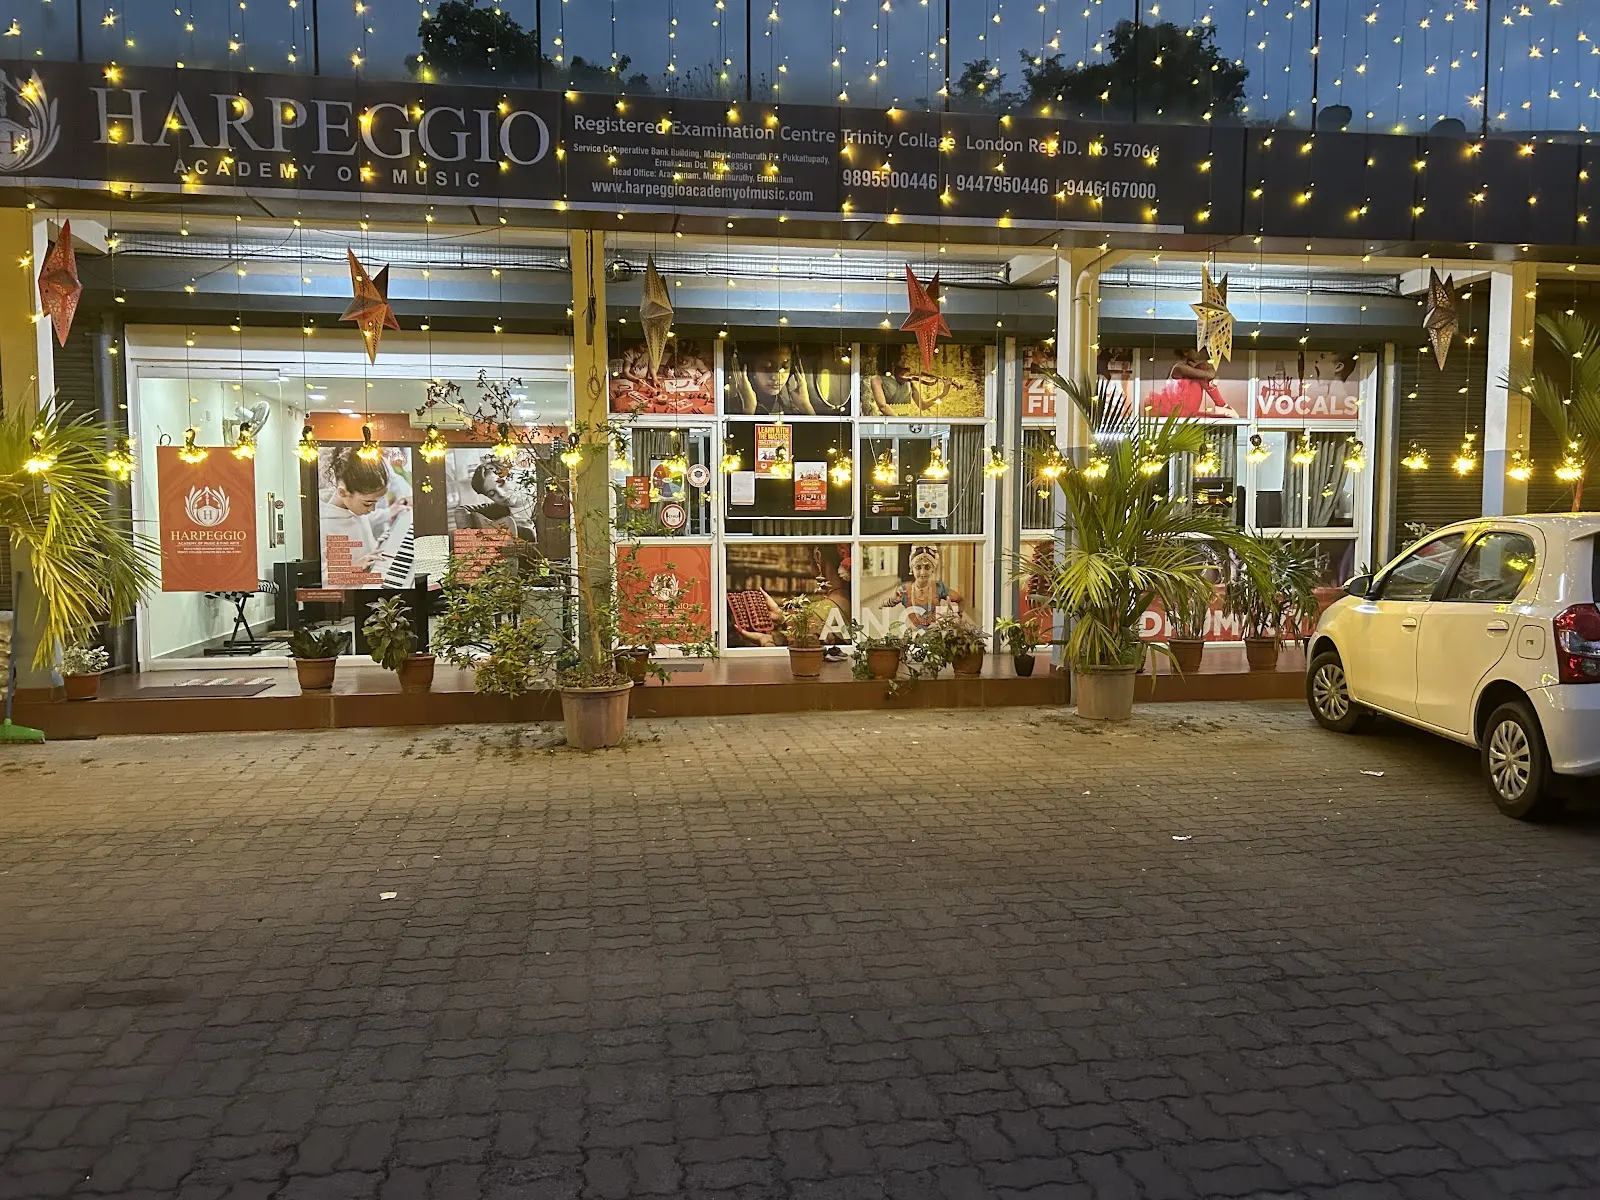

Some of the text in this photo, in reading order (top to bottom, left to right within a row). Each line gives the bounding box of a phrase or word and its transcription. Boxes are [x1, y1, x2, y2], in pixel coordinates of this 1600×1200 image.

[89, 87, 549, 165] HARPEGGIO
[574, 115, 666, 135] Registered
[671, 120, 774, 140] Examination
[780, 126, 836, 143] Centre
[841, 129, 893, 148] Trinity
[899, 132, 956, 151] Collage
[966, 135, 1023, 152] London
[1113, 143, 1160, 159] 57066
[573, 143, 601, 153] Service
[651, 147, 669, 156] Bank
[671, 147, 702, 159] Building,
[173, 158, 480, 188] ACADEMY OF MUSIC
[695, 161, 708, 169] Dst.
[612, 168, 631, 176] Head
[633, 168, 656, 177] Office:
[757, 174, 794, 184] Ernakulam
[843, 169, 1157, 199] 9895500446 9447950446 9446167000
[592, 181, 813, 201] www.harpeggioacademyofmusic.com
[1257, 394, 1358, 416] VOCALS
[171, 530, 247, 541] HARPEGGIO
